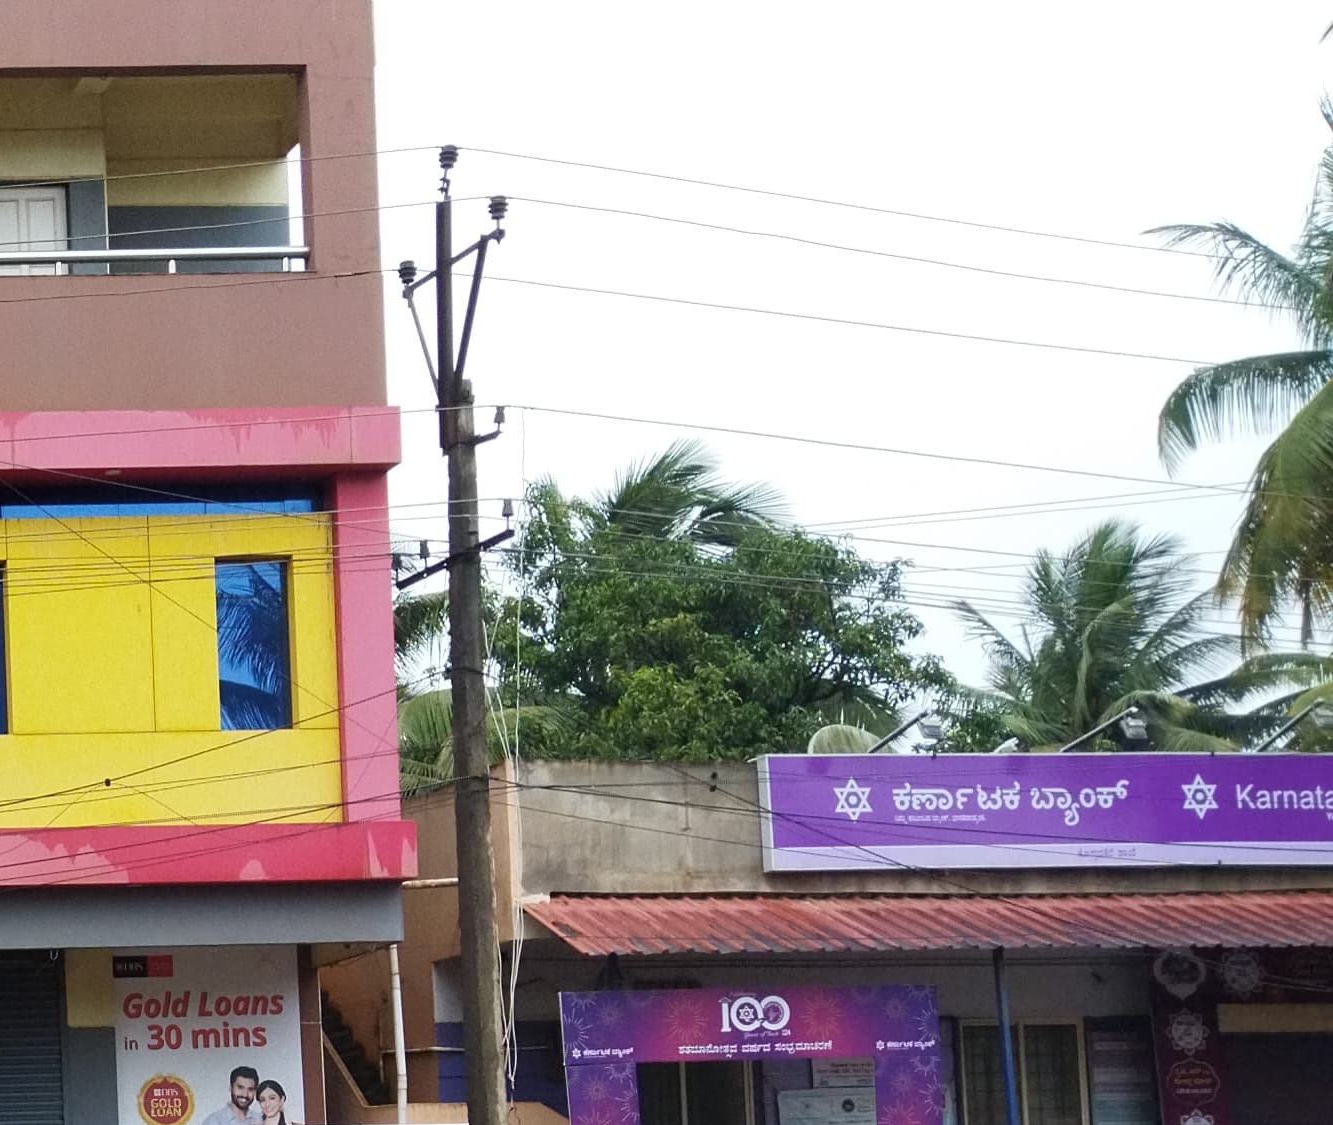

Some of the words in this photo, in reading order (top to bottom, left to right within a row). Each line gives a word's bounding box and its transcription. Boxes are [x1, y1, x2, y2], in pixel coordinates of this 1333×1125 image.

[893, 782, 1020, 810] ಕರ್ನಾಟಕ
[1031, 780, 1129, 825] ಬ್ಯಾಂಕ್
[1236, 784, 1333, 809] Karnata
[123, 991, 191, 1019] Gold
[198, 993, 284, 1017] Loans
[719, 995, 790, 1032] 100
[124, 1037, 138, 1050] in
[147, 1024, 182, 1050] 30
[192, 1022, 267, 1049] mins
[150, 1099, 182, 1108] GOLD
[150, 1108, 182, 1117] LOAN
